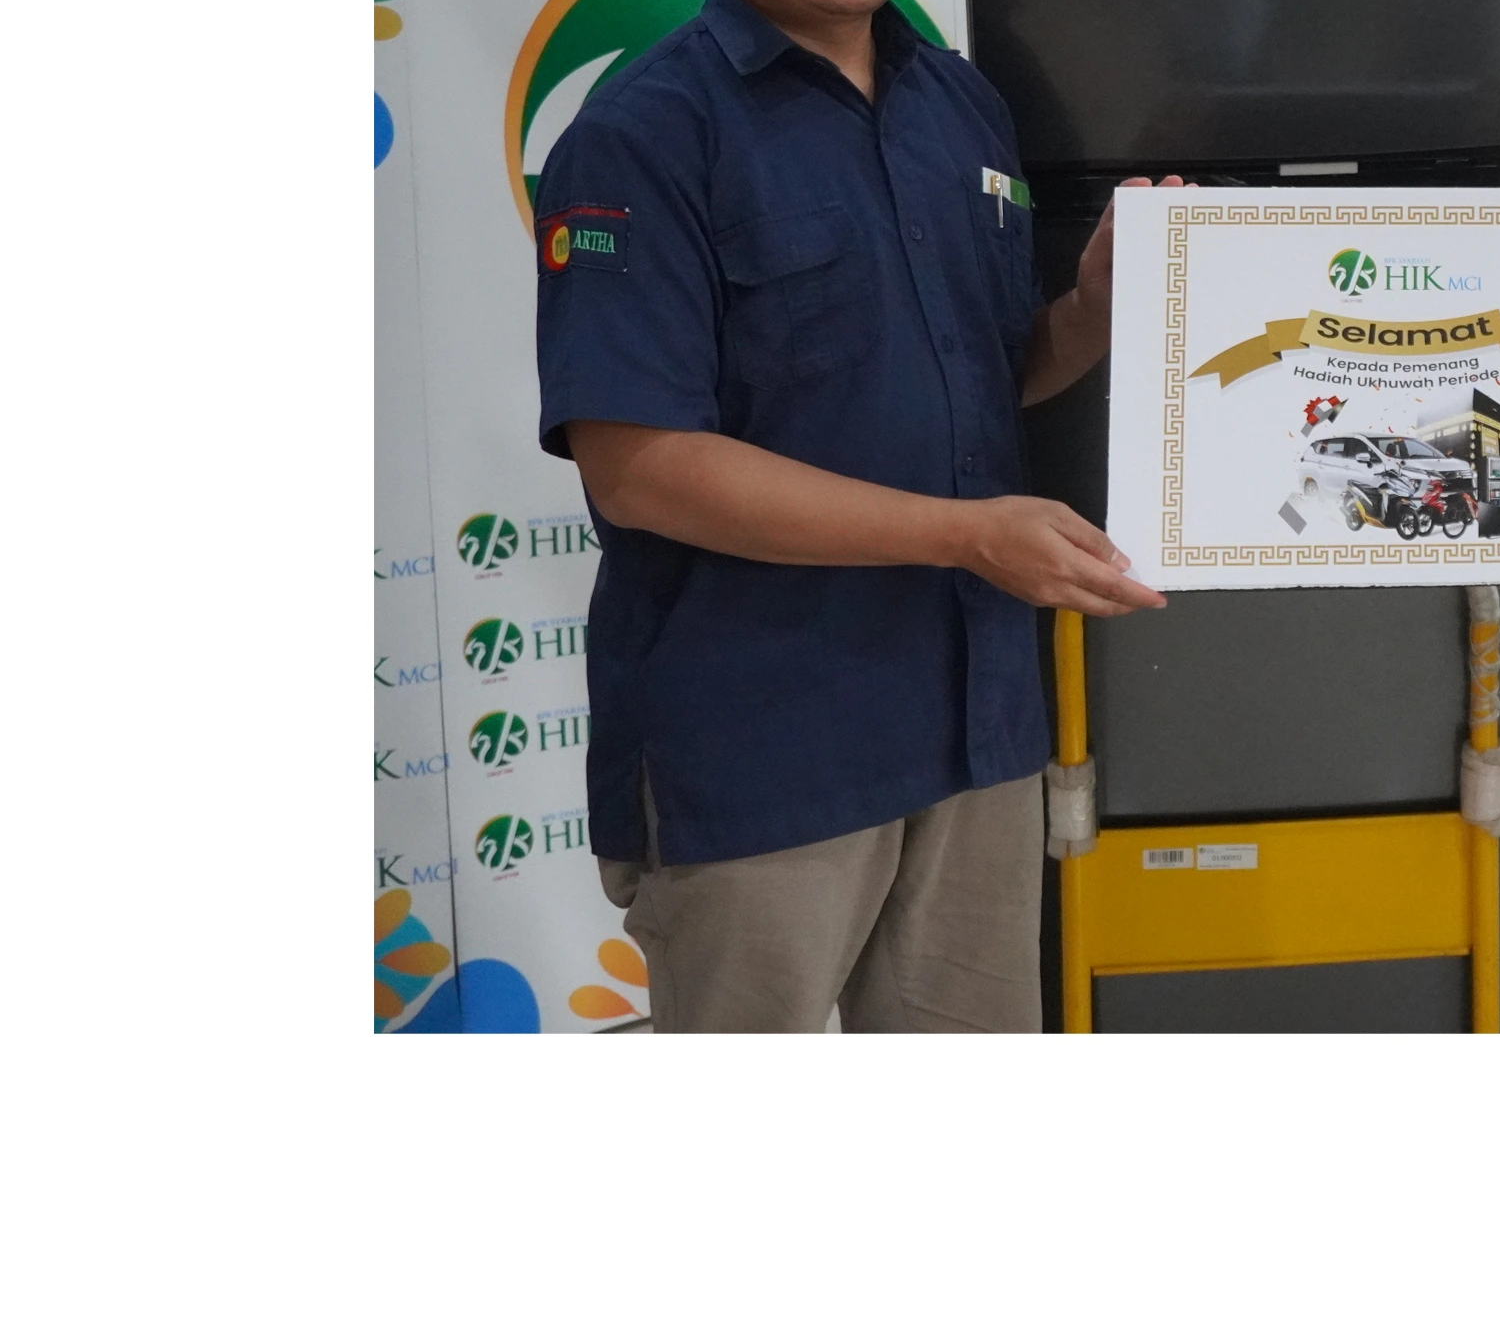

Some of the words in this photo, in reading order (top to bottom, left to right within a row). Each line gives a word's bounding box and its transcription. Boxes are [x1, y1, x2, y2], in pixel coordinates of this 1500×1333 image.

[573, 230, 616, 253] ARTHA
[1384, 266, 1446, 290] HIK
[1448, 277, 1481, 290] MCI
[1317, 317, 1493, 346] Selamat
[1327, 357, 1388, 372] Kepada
[1394, 358, 1479, 372] Pemenang
[1294, 367, 1351, 385] Hadiah
[1358, 377, 1434, 388] Ukhuwah
[1439, 369, 1499, 386] Periode
